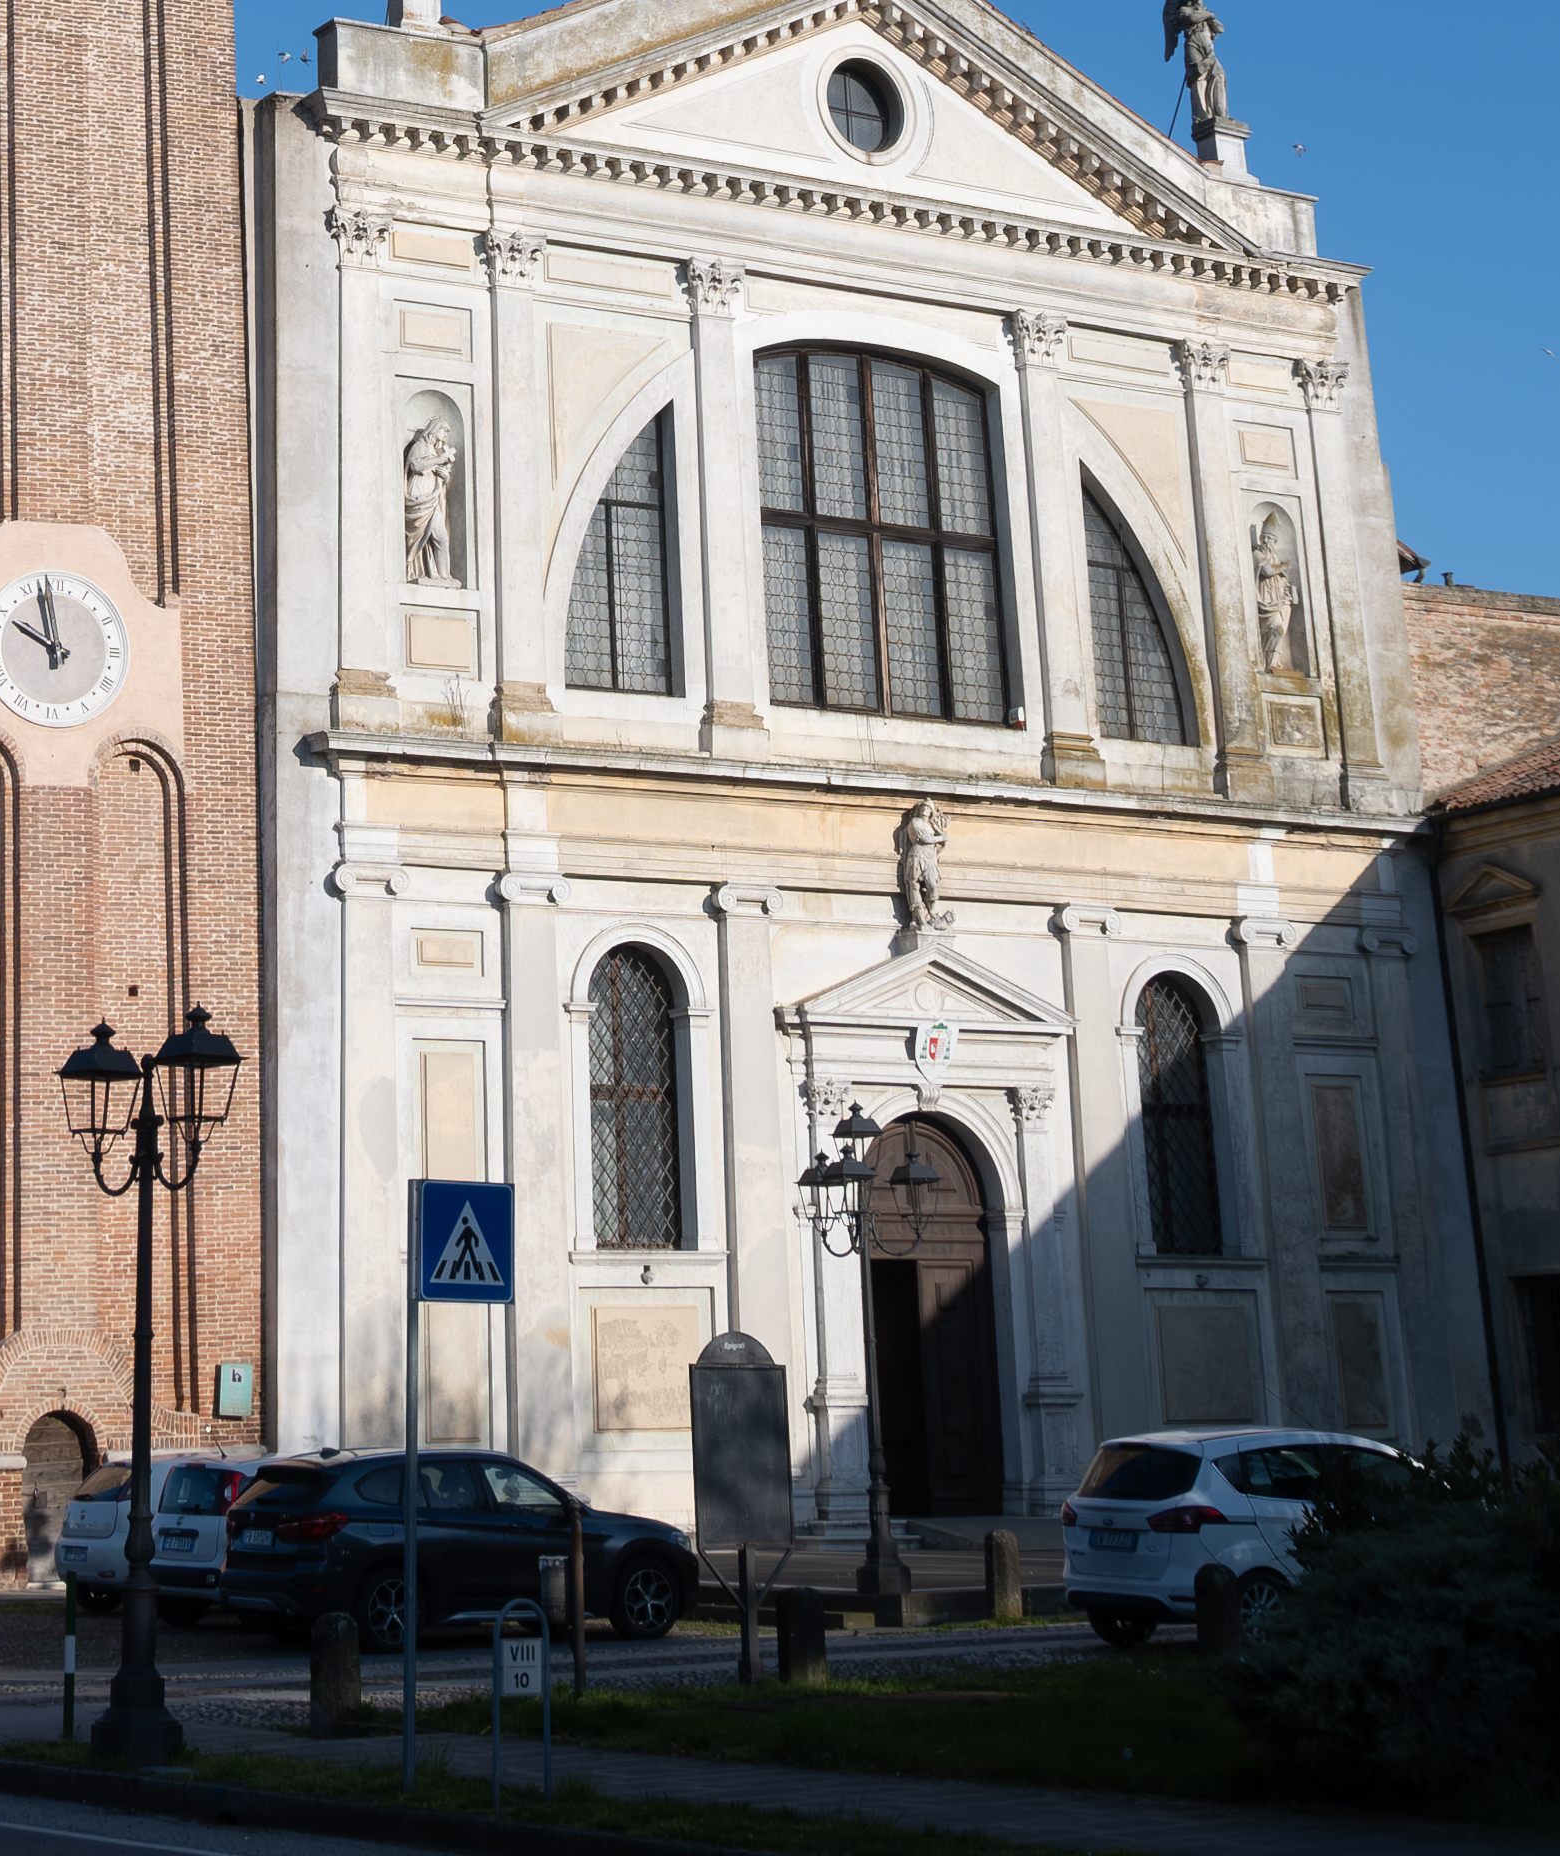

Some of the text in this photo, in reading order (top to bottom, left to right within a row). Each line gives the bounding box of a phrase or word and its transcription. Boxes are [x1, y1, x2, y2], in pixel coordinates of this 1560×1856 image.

[19, 583, 33, 597] XI
[81, 590, 89, 601] I
[101, 616, 114, 626] II
[109, 647, 120, 658] III
[99, 676, 114, 693] IIII
[13, 694, 29, 711] VII
[80, 702, 90, 714] V
[46, 707, 59, 719] VI
[510, 1645, 535, 1661] VIII
[514, 1672, 529, 1688] 10
